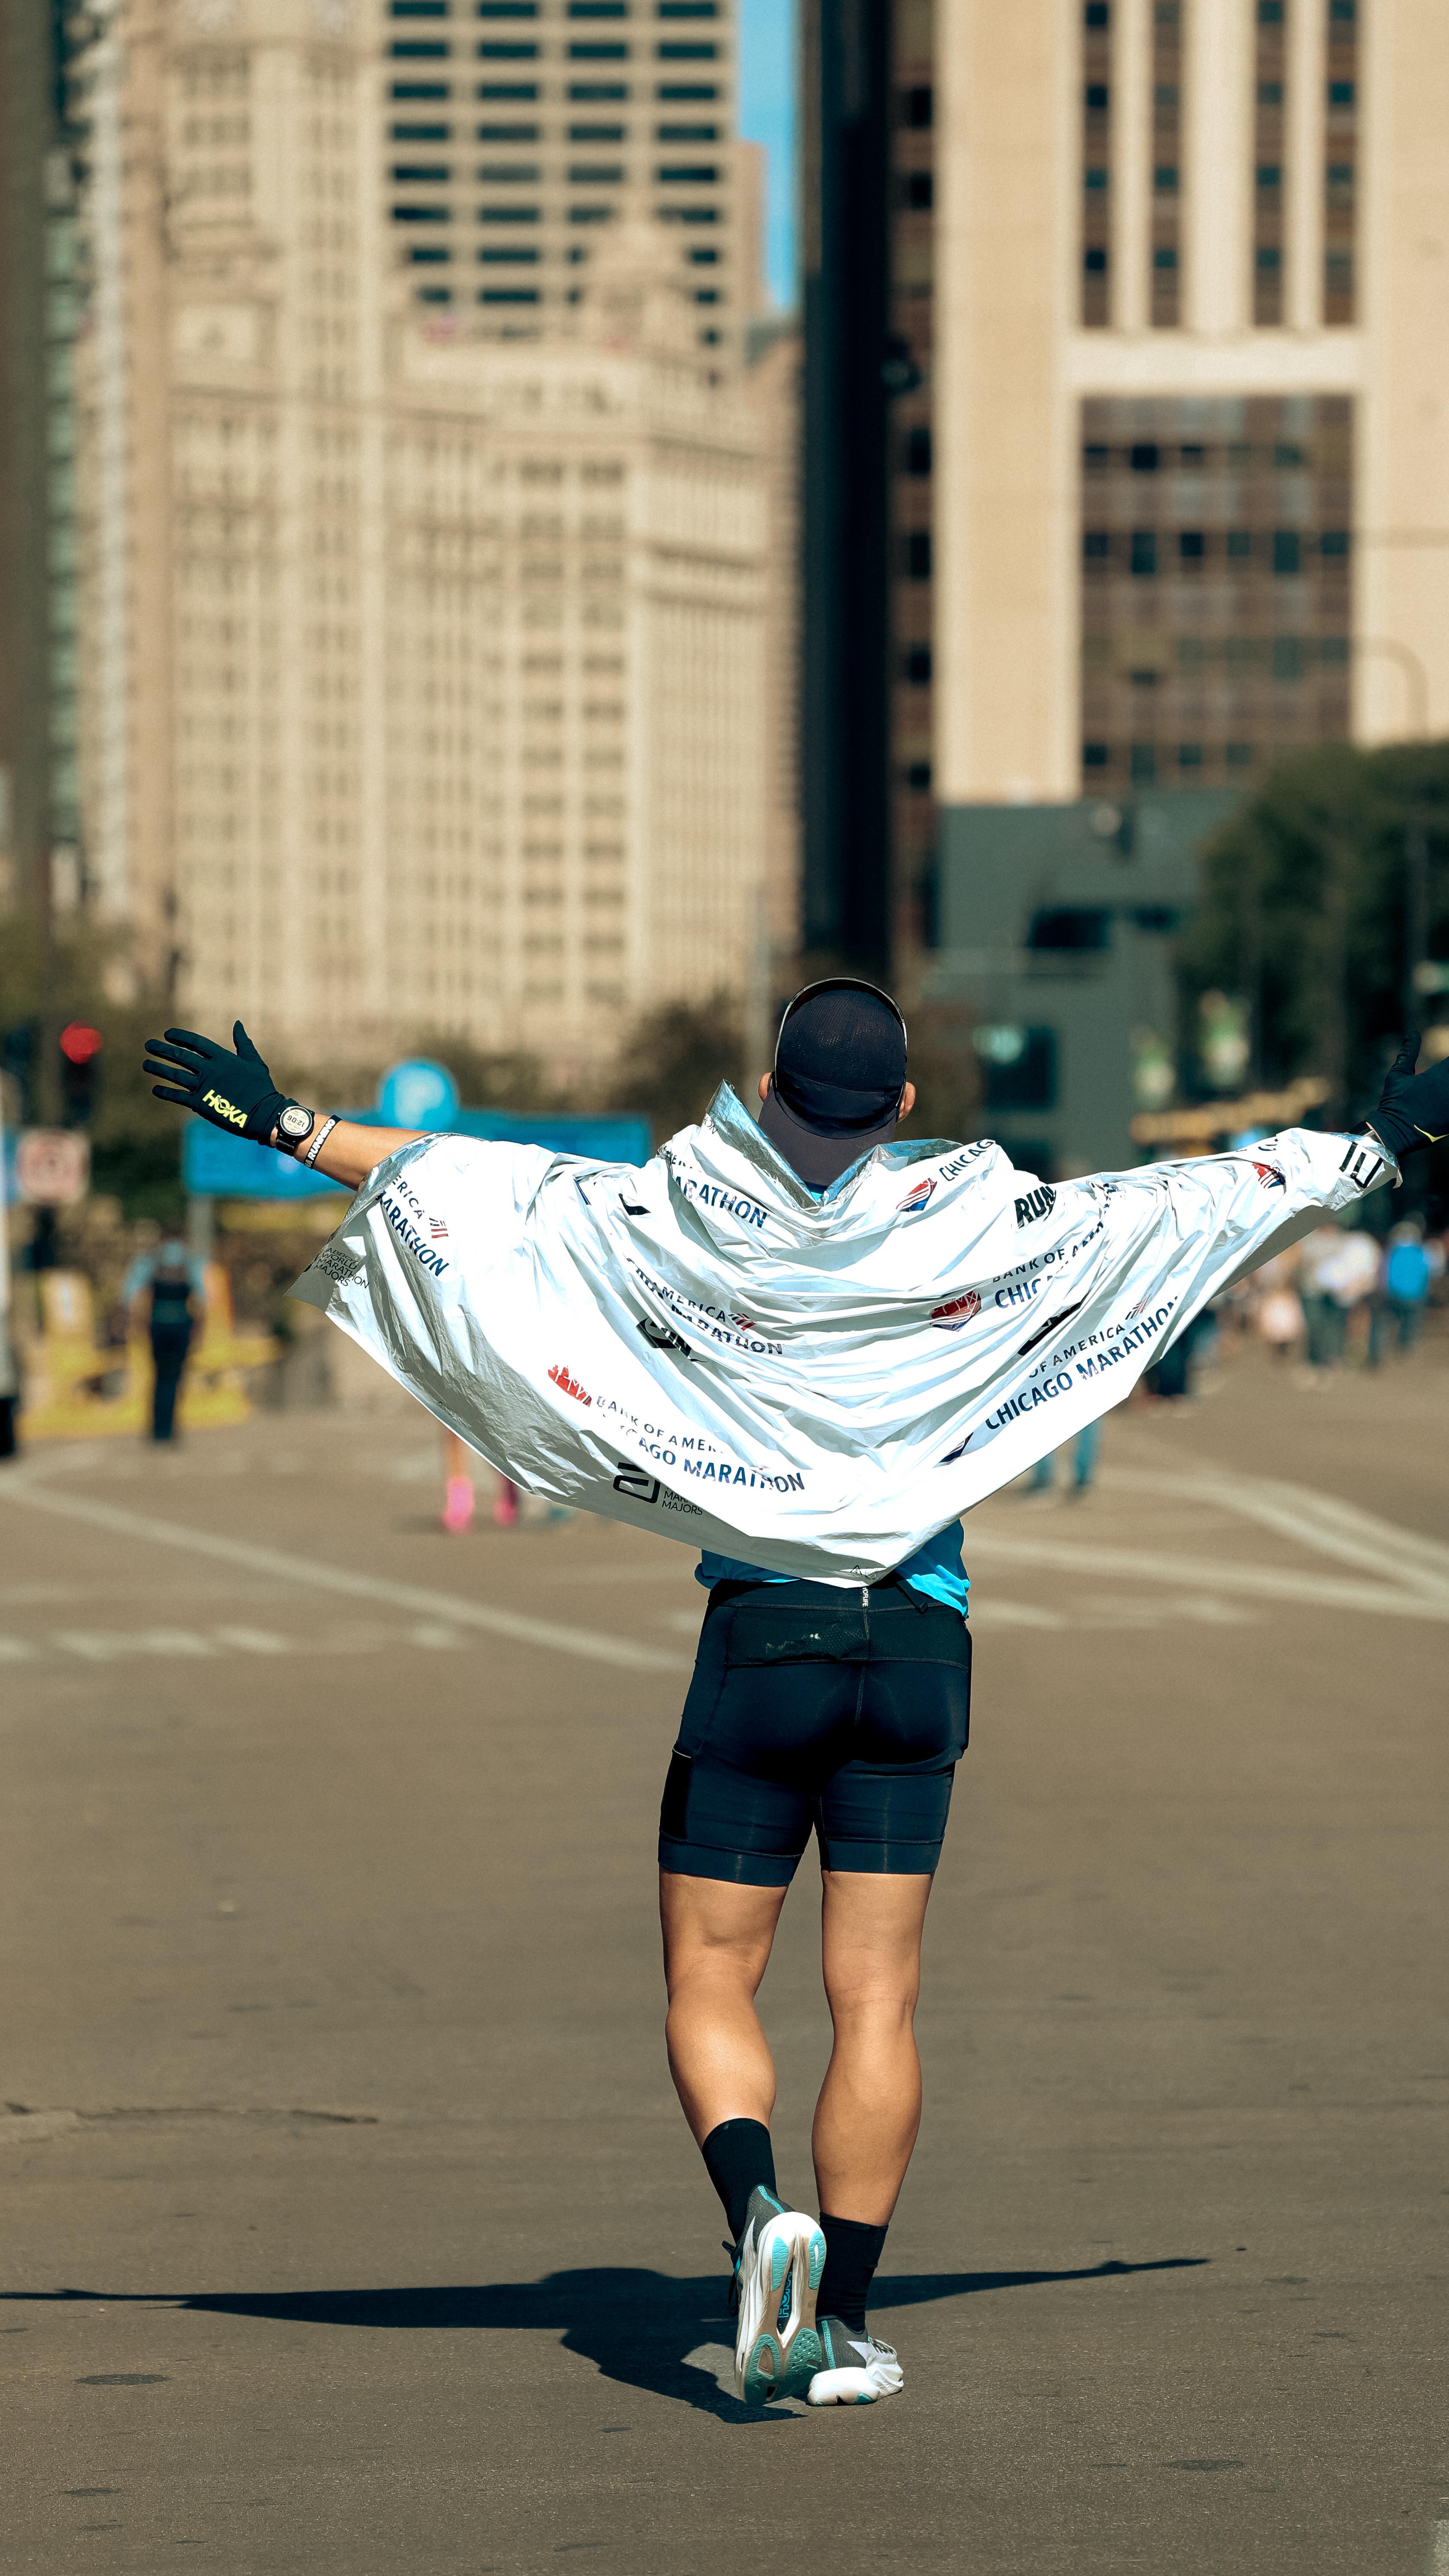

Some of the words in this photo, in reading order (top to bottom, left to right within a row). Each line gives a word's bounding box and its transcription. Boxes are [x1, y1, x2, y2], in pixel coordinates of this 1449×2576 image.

[202, 1089, 248, 1129] HOKA
[287, 1115, 305, 1127] 12:06
[307, 1119, 336, 1160] RUNNING
[322, 1253, 357, 1270] WORLD
[1044, 1249, 1064, 1264] OF
[313, 1264, 350, 1287] MAJORS
[317, 1258, 370, 1289] MARATHON
[653, 1282, 726, 1322] MERICA
[1053, 1324, 1125, 1367] AMERICA
[985, 1372, 1073, 1430] CHICAGO
[644, 1423, 664, 1438] OF
[662, 1500, 703, 1516] MAJORS
[778, 2271, 792, 2318] HO
